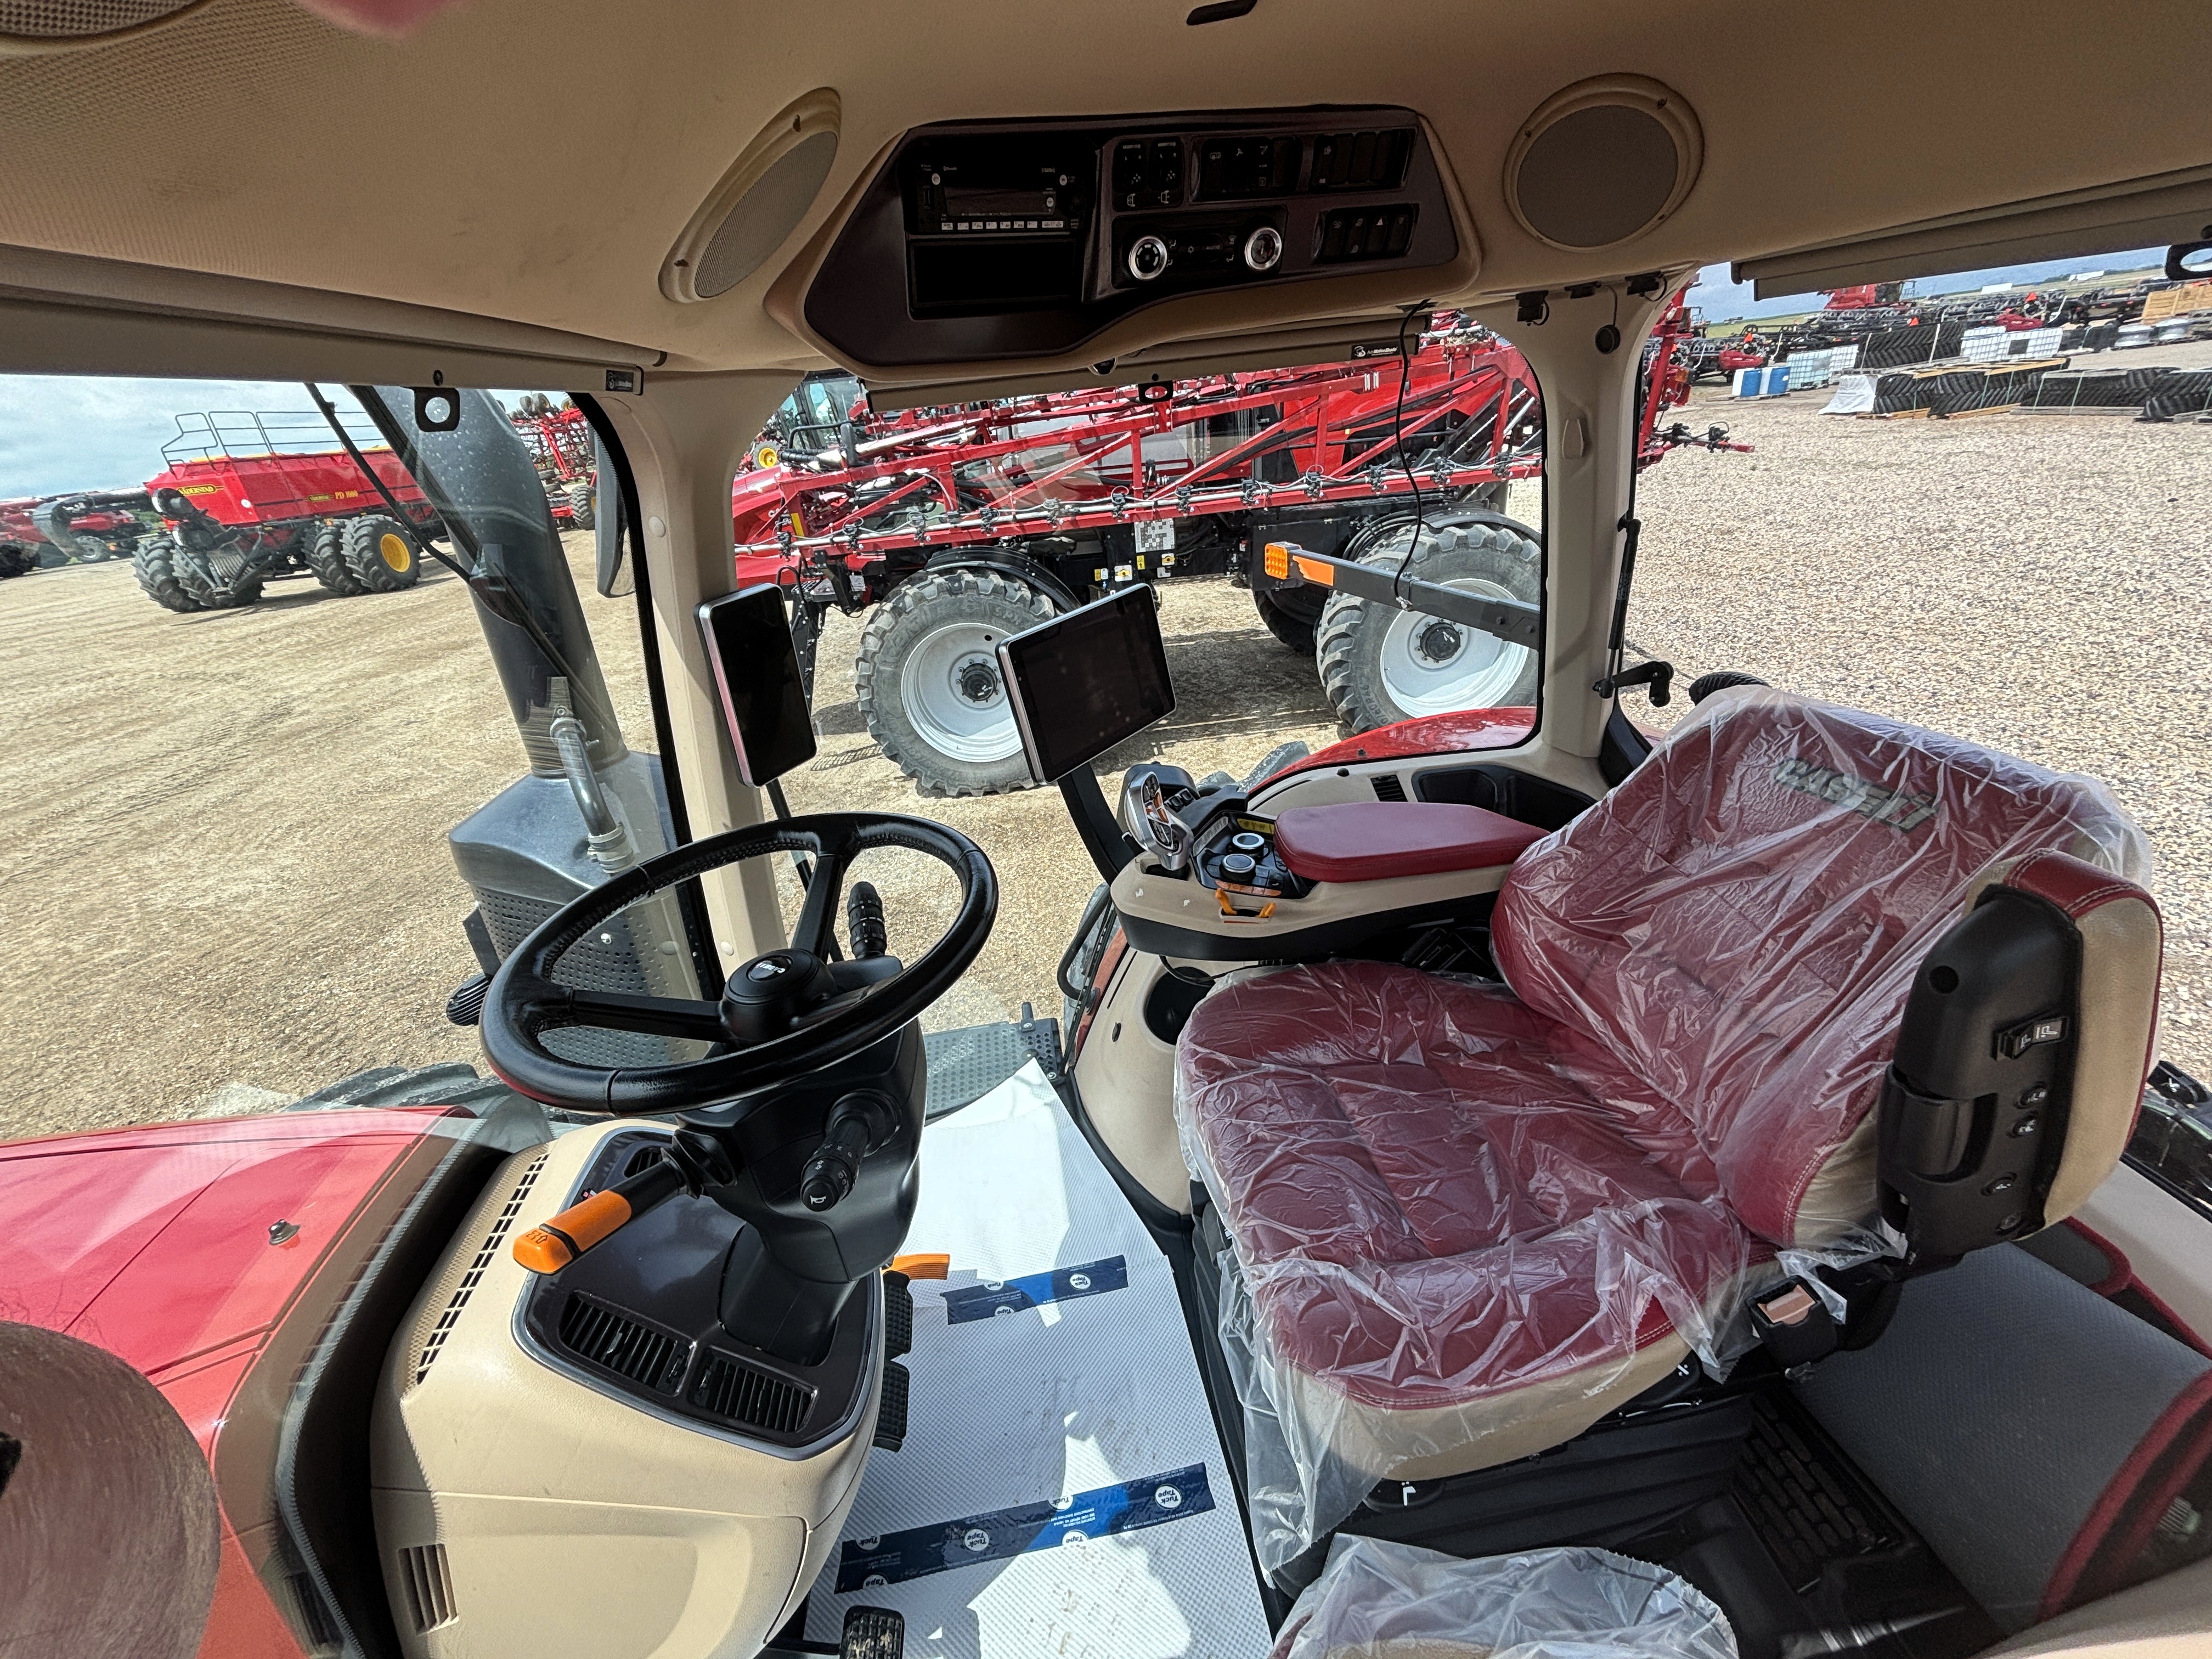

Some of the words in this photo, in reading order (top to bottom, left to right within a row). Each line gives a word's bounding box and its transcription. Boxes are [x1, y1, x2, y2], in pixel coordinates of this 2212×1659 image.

[335, 492, 345, 500] PD
[1158, 1489, 1176, 1498] Tape
[1053, 1496, 1070, 1505] Tuck
[1161, 1495, 1179, 1504] Tuck
[859, 1536, 878, 1546] Tuck
[968, 1538, 987, 1547] Tuck
[865, 1578, 885, 1587] Tape
